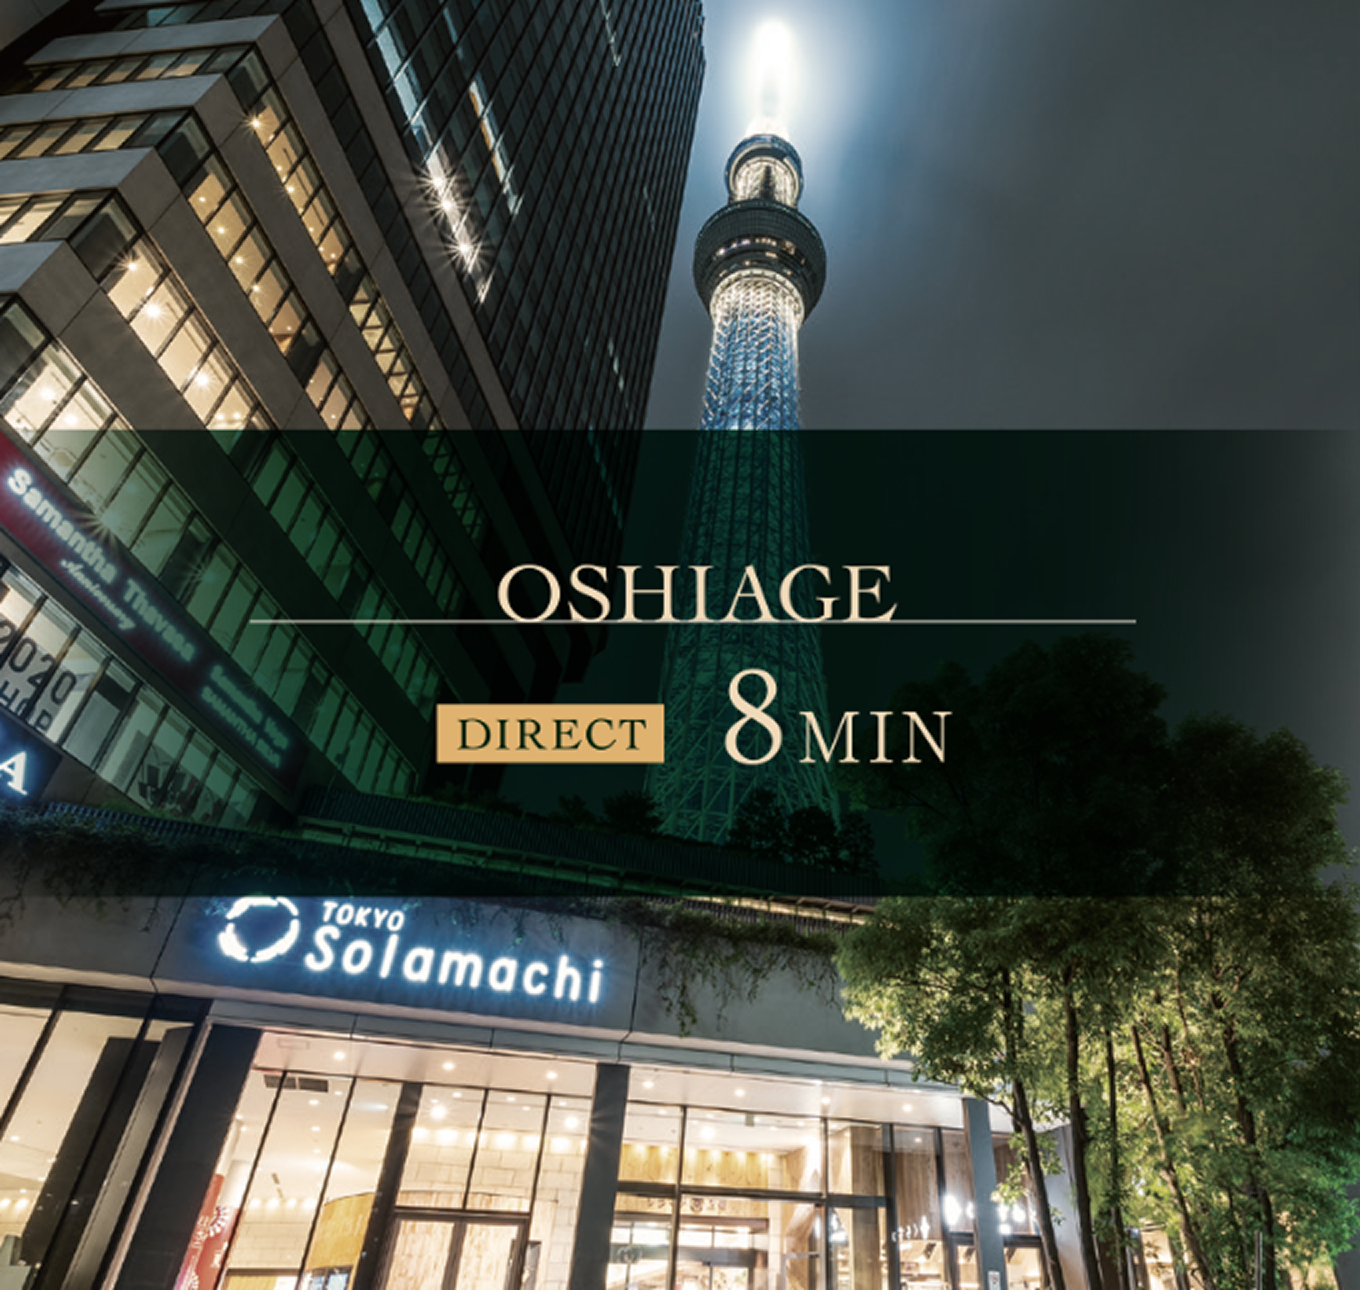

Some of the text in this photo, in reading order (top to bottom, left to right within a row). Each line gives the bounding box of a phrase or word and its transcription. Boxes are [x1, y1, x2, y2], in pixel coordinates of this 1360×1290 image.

[7, 467, 118, 585] Samantha
[321, 901, 405, 931] TOKYO
[304, 924, 606, 1004] Solamachi
